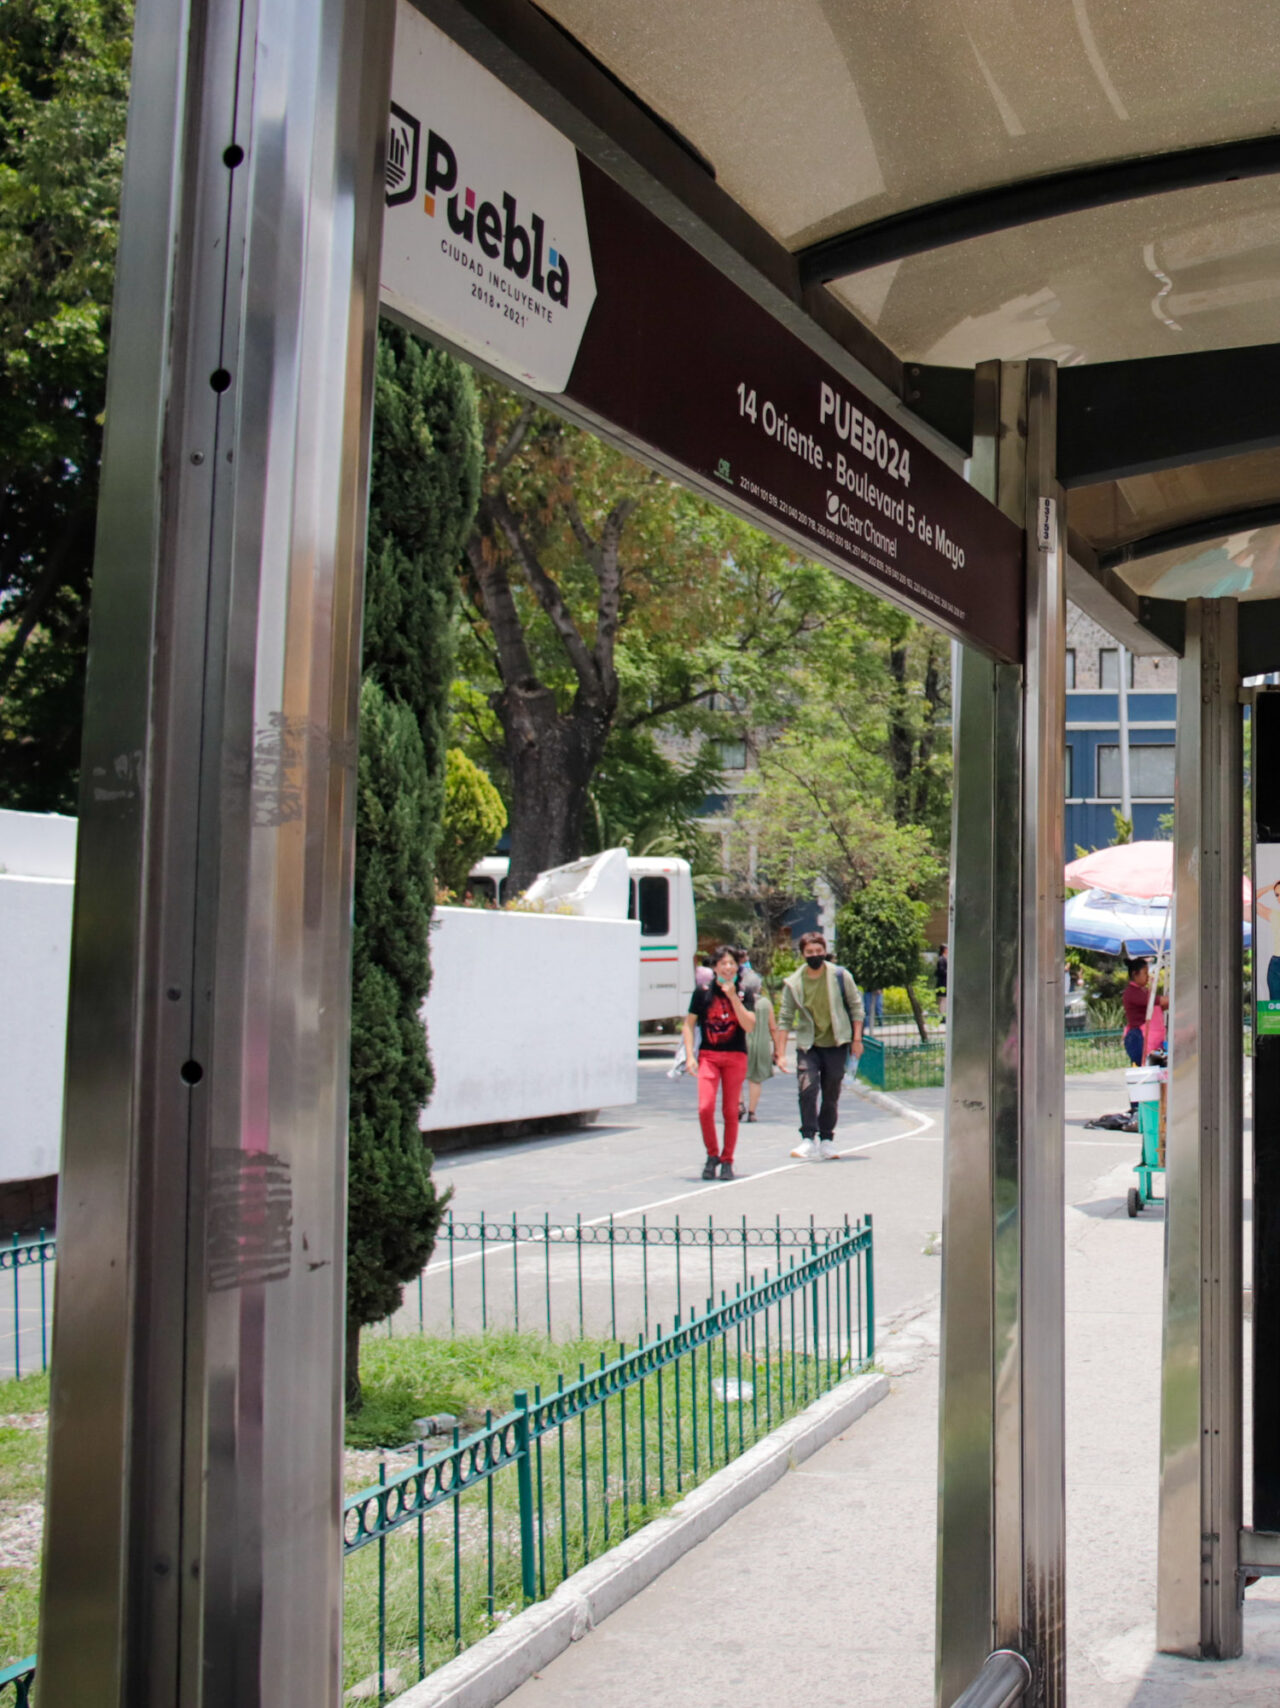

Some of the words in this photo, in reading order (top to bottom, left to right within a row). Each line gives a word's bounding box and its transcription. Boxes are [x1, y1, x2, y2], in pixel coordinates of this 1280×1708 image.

[424, 128, 569, 309] Puebla
[441, 239, 483, 277] CIUDAD
[489, 271, 553, 324] INCLUYENTE
[471, 283, 495, 308] 2018
[504, 304, 526, 328] 2021
[737, 382, 758, 424] 14
[762, 401, 823, 470] Oriente
[836, 452, 904, 526] Boulevard
[907, 504, 915, 534] 5
[918, 514, 932, 547] de
[935, 525, 965, 570] Mayo
[820, 381, 911, 488] PUEB024
[840, 504, 864, 537] Clear
[864, 520, 898, 559] Channel
